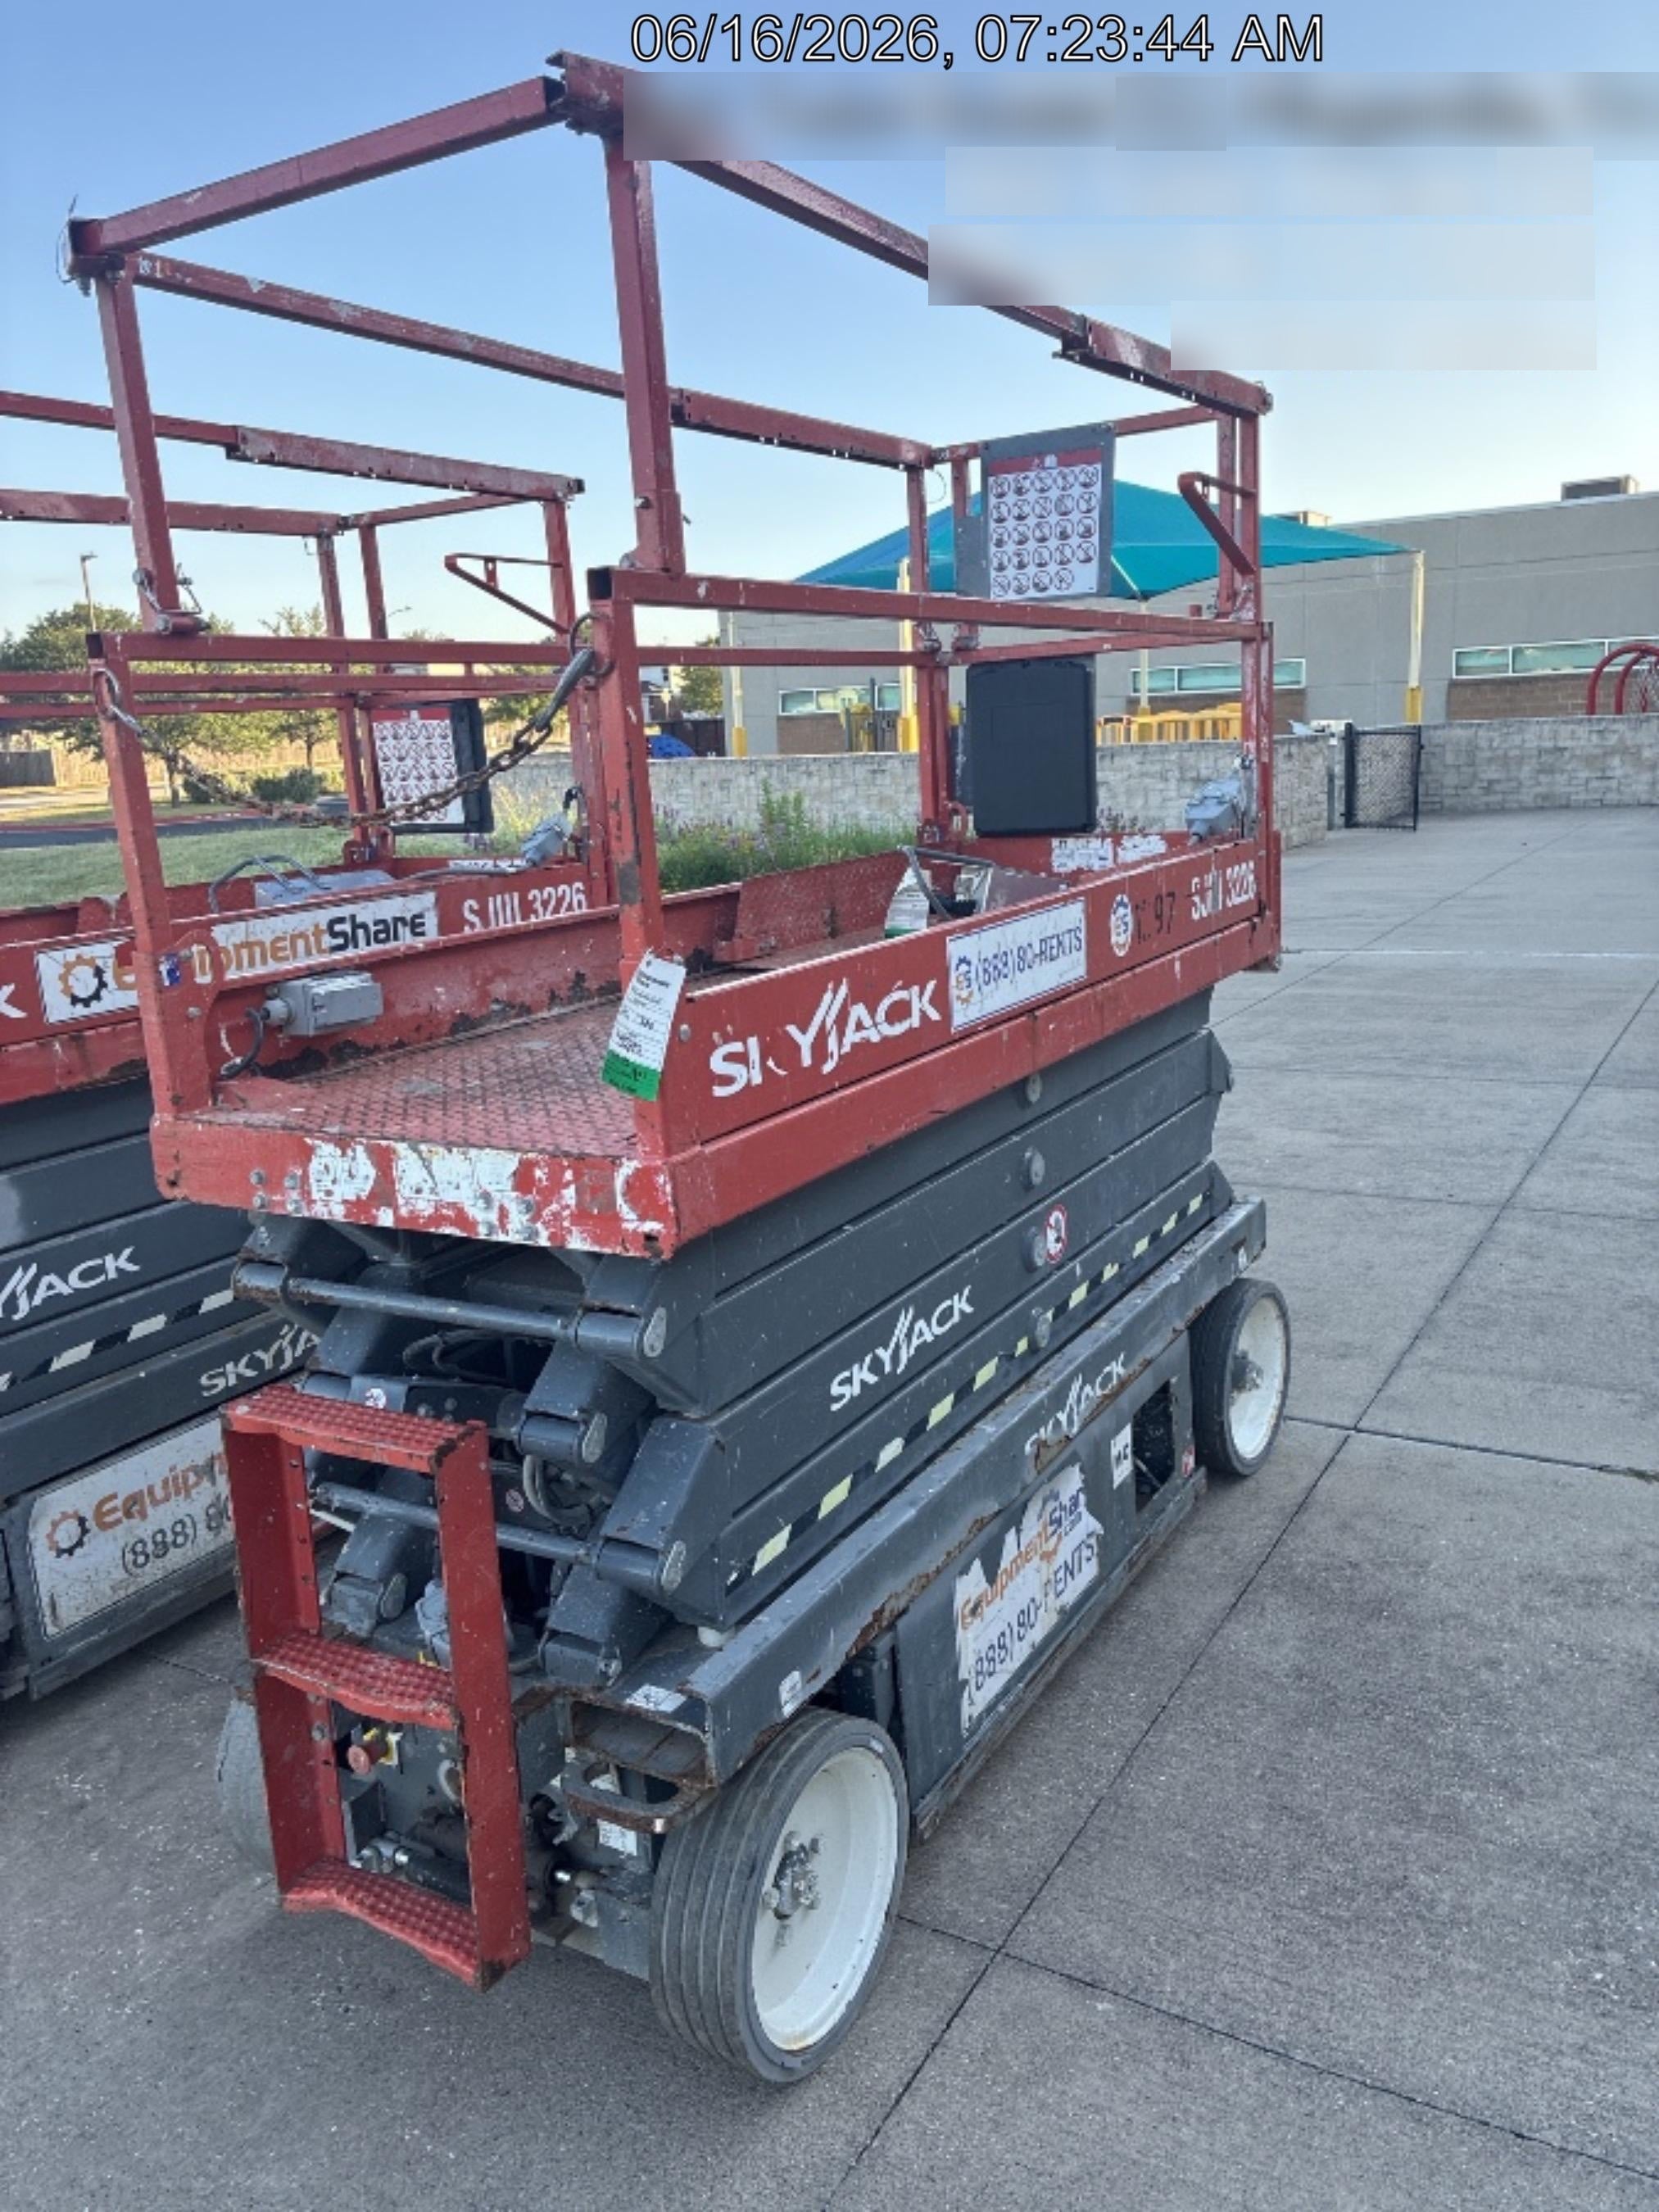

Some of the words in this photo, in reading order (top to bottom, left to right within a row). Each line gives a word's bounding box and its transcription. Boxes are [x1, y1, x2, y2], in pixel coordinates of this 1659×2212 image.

[527, 881, 588, 922] 3226
[829, 1284, 975, 1412] SKYJACK
[121, 1513, 197, 1578] (888)
